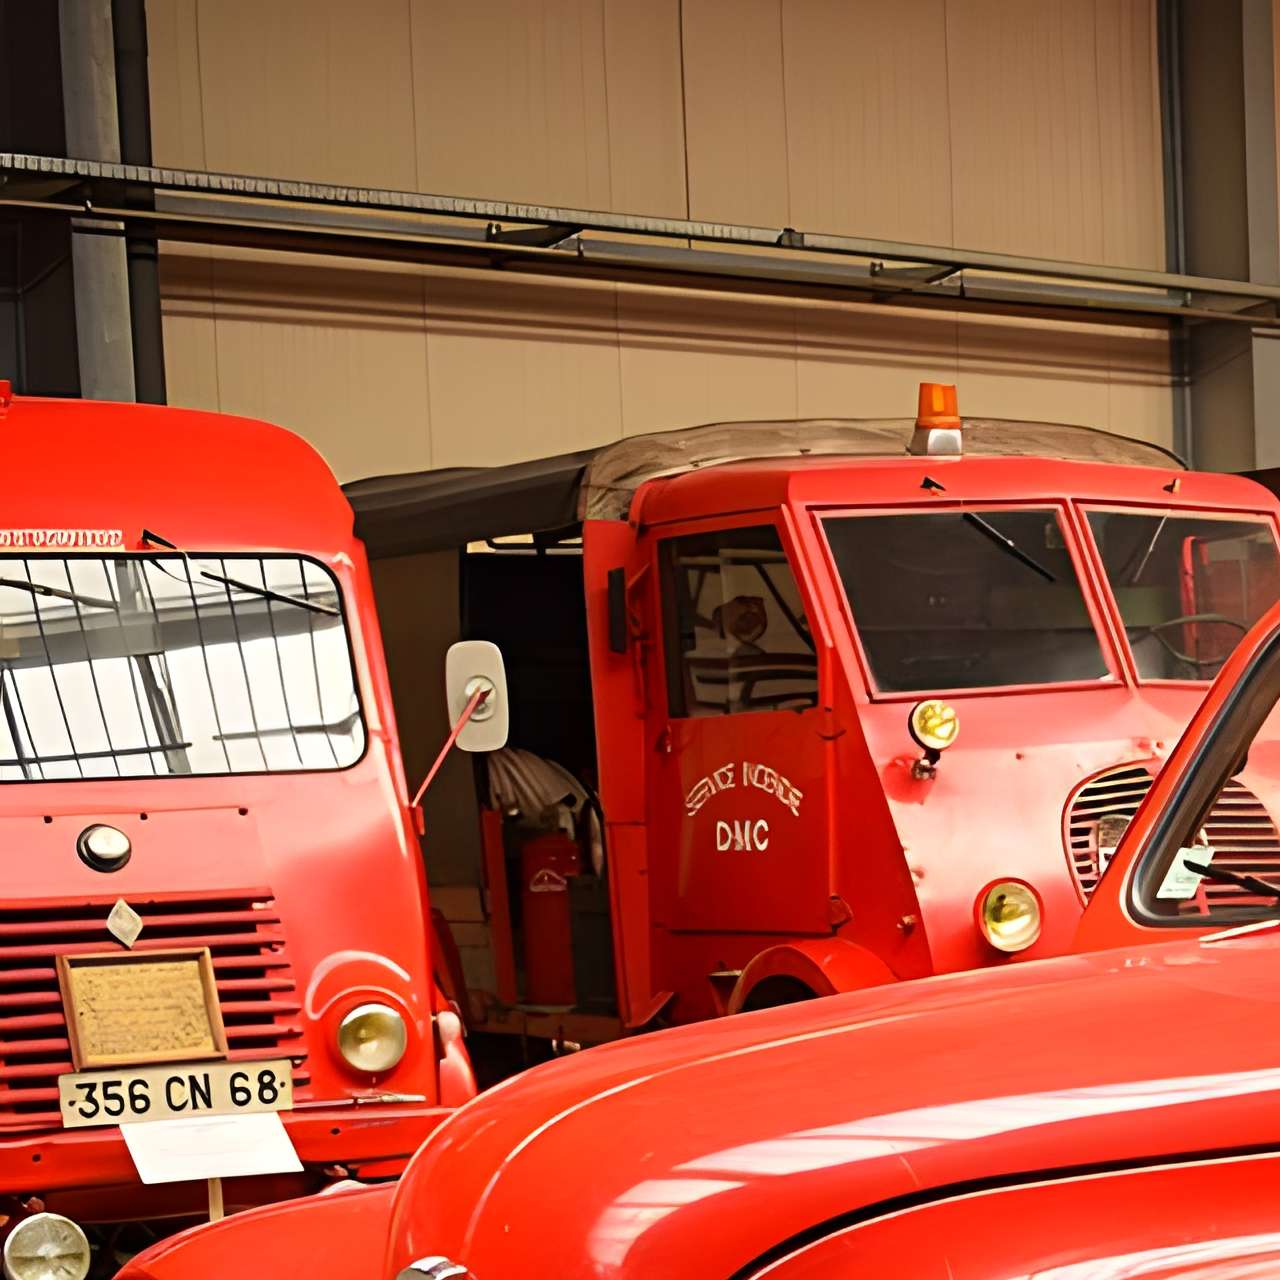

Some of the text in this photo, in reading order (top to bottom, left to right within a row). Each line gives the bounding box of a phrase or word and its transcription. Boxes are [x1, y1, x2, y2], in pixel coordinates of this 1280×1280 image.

[75, 1069, 279, 1119] 356 CN 68
